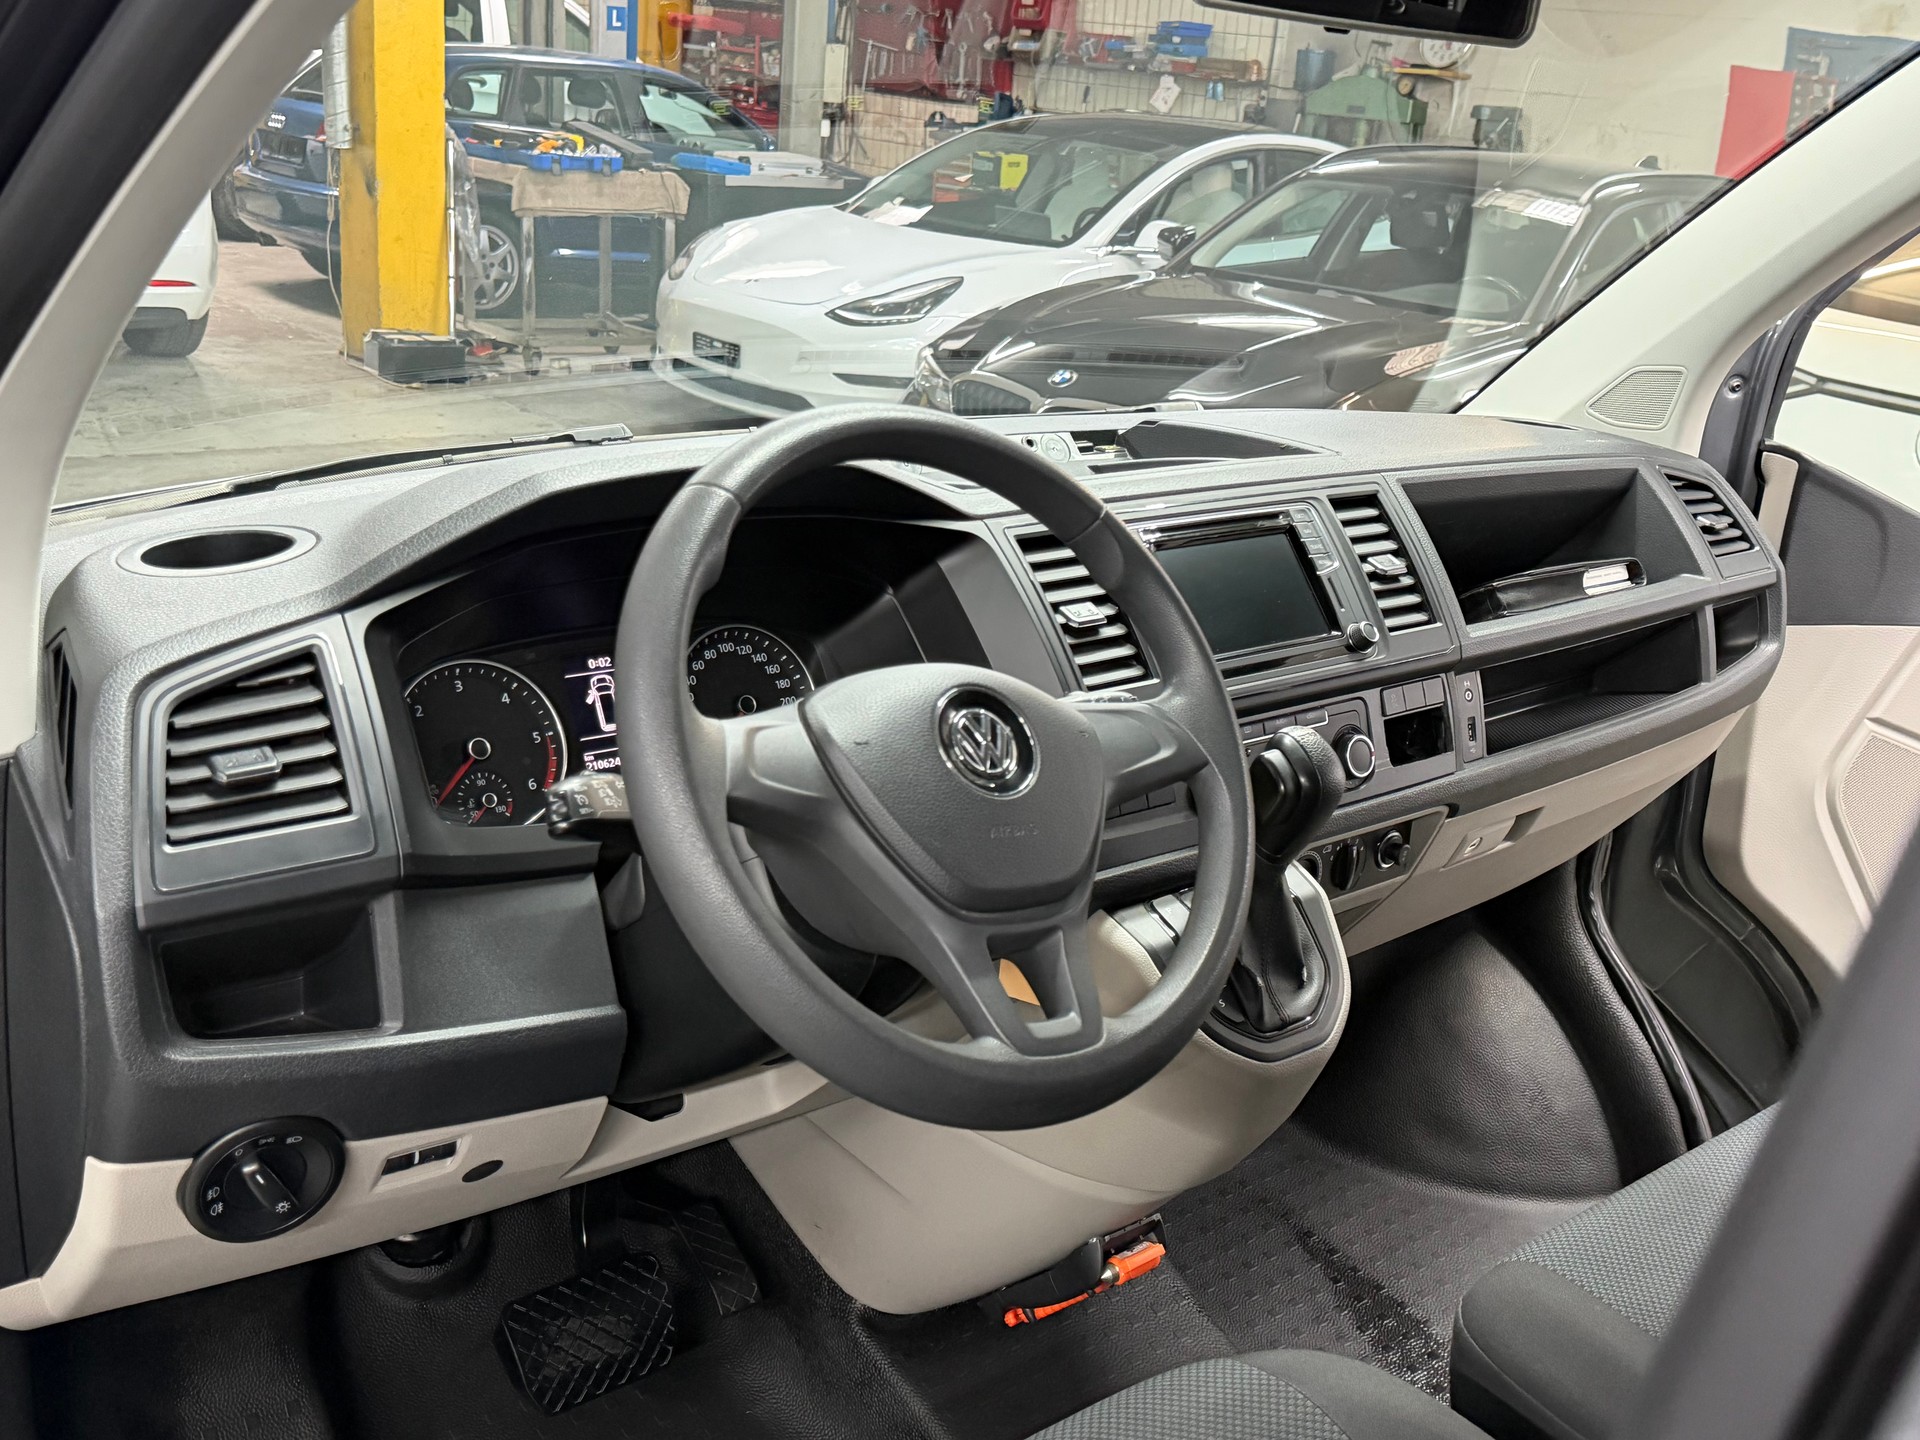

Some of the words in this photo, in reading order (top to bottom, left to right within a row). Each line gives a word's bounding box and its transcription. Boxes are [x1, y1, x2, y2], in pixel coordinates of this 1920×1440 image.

[612, 9, 622, 27] L
[718, 642, 735, 653] 100
[735, 644, 753, 656] 120
[704, 649, 717, 660] 80
[751, 652, 768, 664] 140
[587, 656, 612, 669] 0:02
[692, 660, 705, 671] 60
[764, 664, 781, 675] 160
[454, 680, 464, 693] 3
[775, 678, 791, 689] 180
[501, 692, 511, 704] 4
[414, 705, 424, 717] 2
[532, 731, 541, 744] 5
[476, 779, 486, 787] 90
[528, 778, 537, 790] 6
[495, 804, 507, 814] 130
